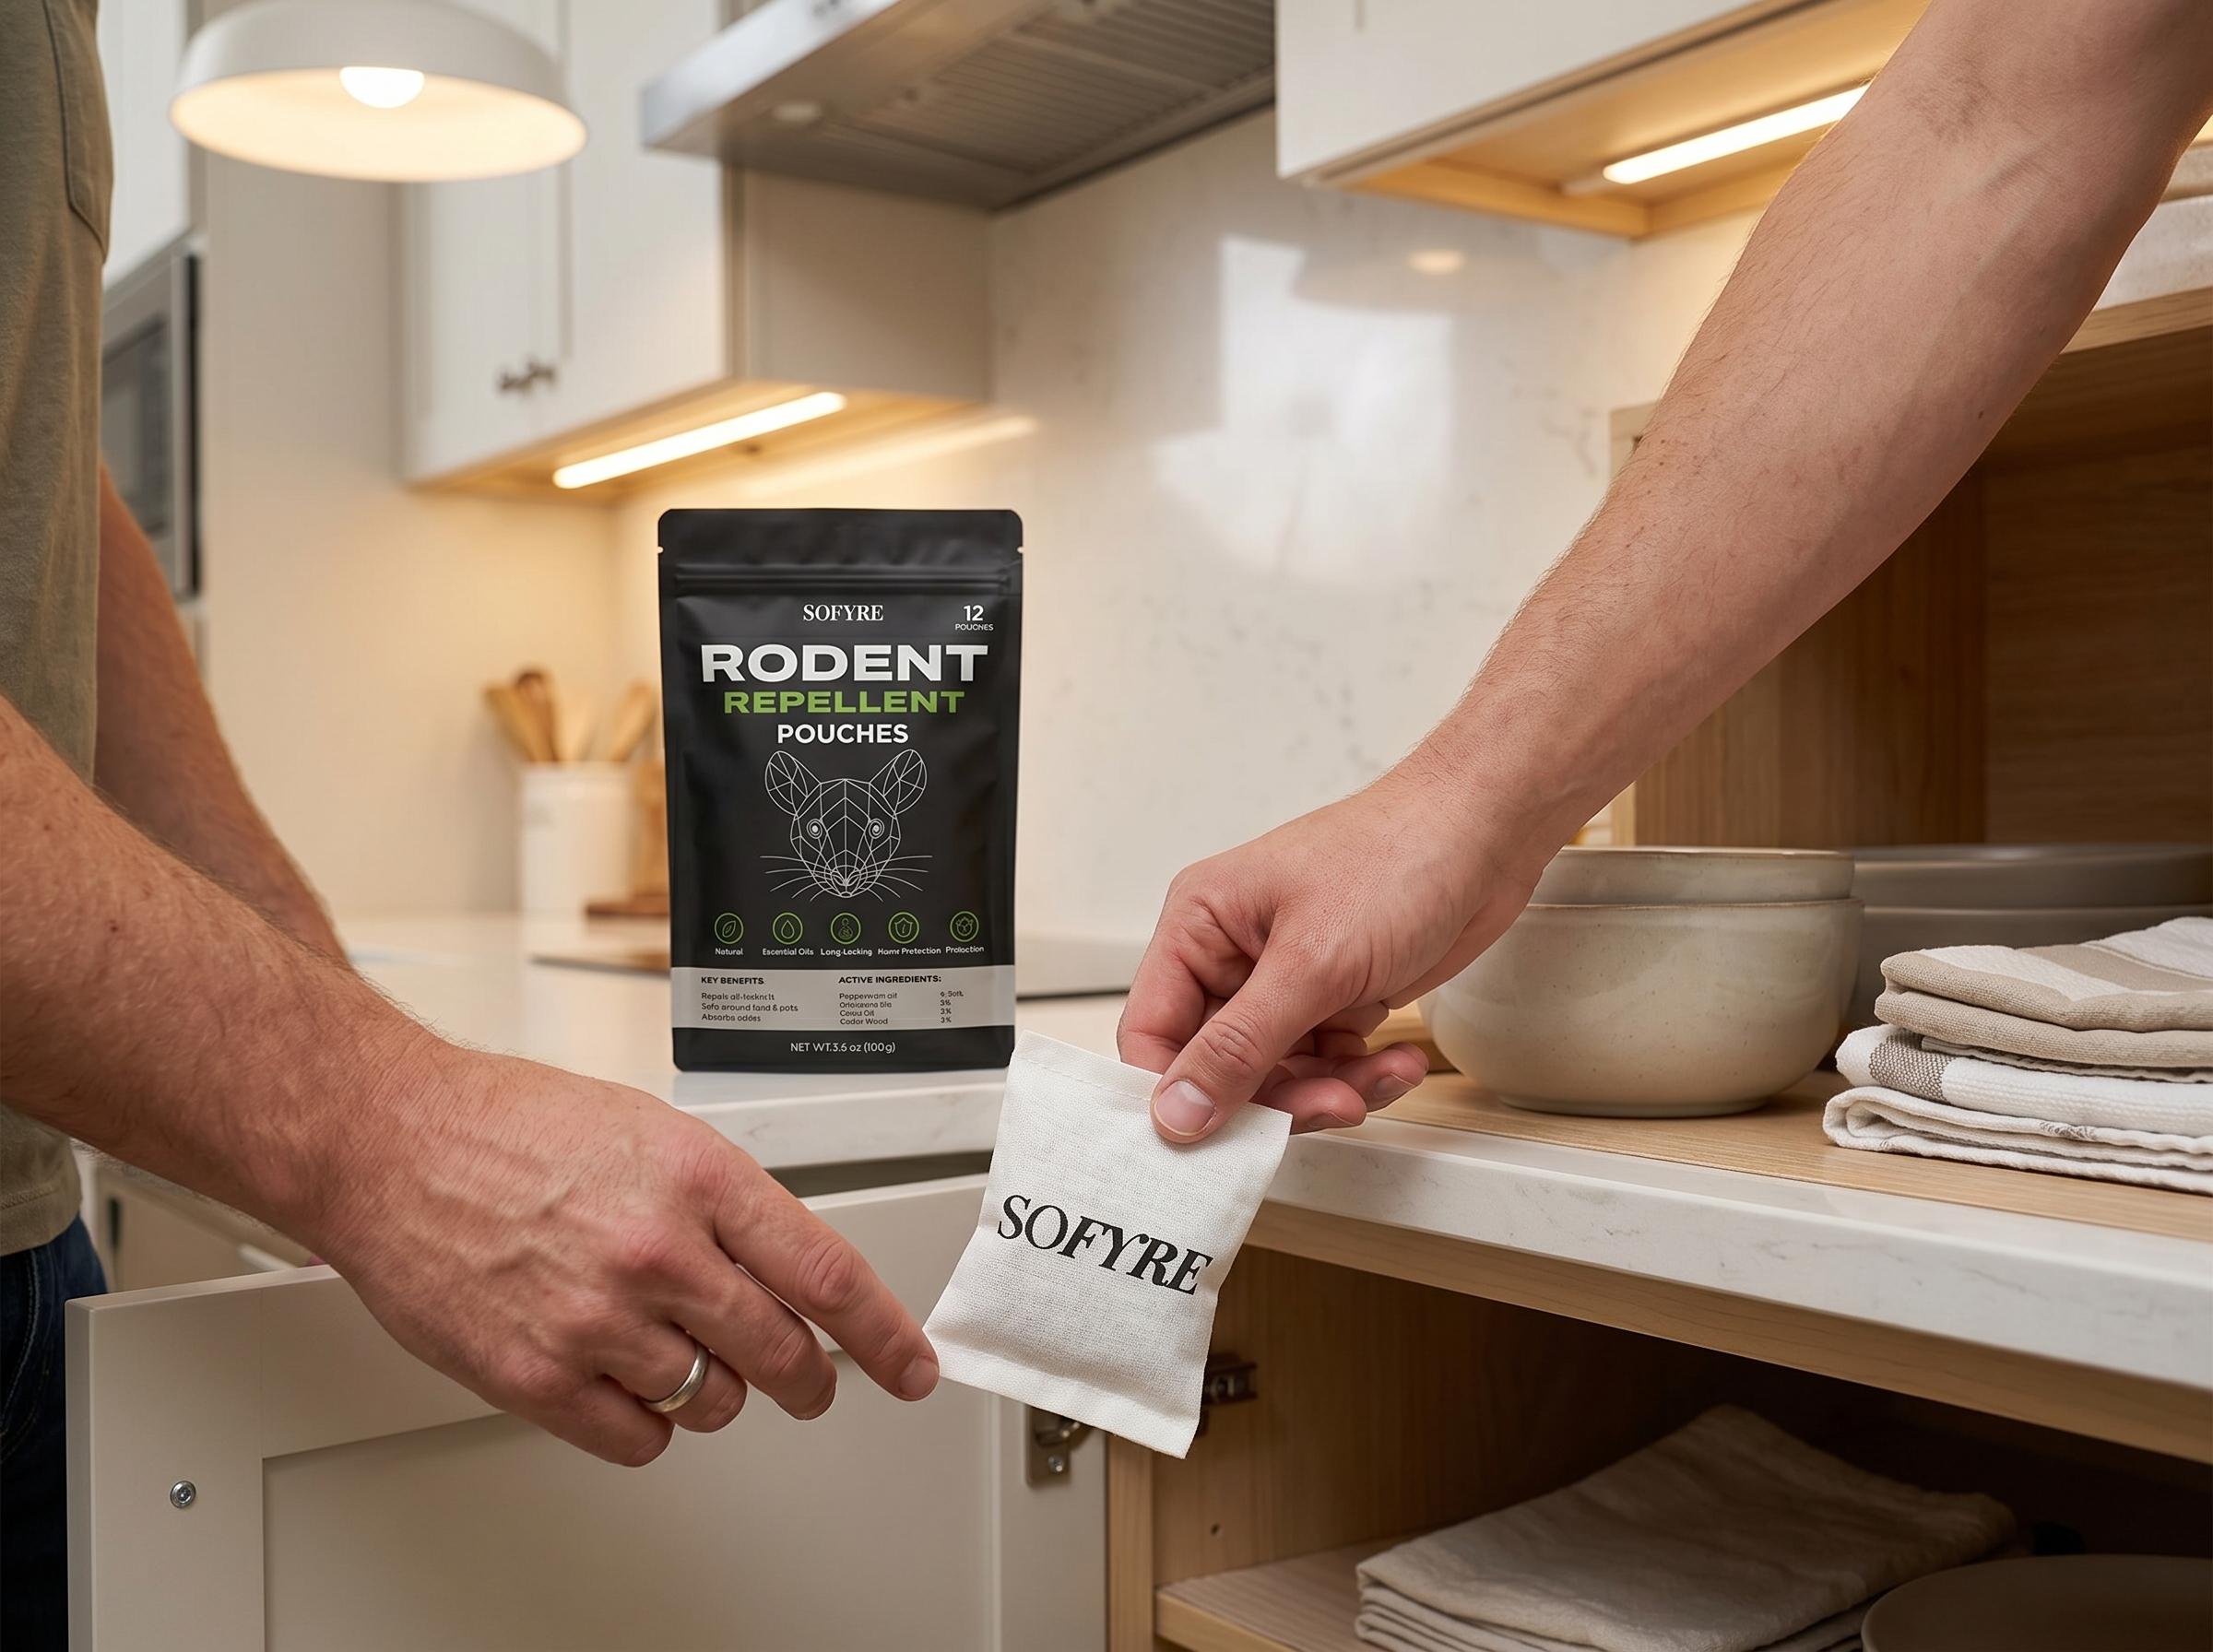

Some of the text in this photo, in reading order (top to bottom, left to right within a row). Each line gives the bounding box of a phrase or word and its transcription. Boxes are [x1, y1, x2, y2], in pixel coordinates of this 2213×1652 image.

[803, 604, 883, 621] SOFYRE
[963, 605, 984, 621] 12
[701, 643, 988, 682] RODENT
[724, 691, 965, 714] REPELLENT
[777, 724, 908, 744] POUCHES
[715, 948, 744, 956] Natural
[798, 948, 814, 956] Oils
[701, 976, 764, 985] KEY BENEFITS
[875, 974, 941, 984] INGREDIENTS:
[790, 1042, 811, 1052] NET
[849, 1044, 861, 1052] oz
[863, 1041, 896, 1054] (100g)
[997, 1194, 1214, 1296] SOFYRE
